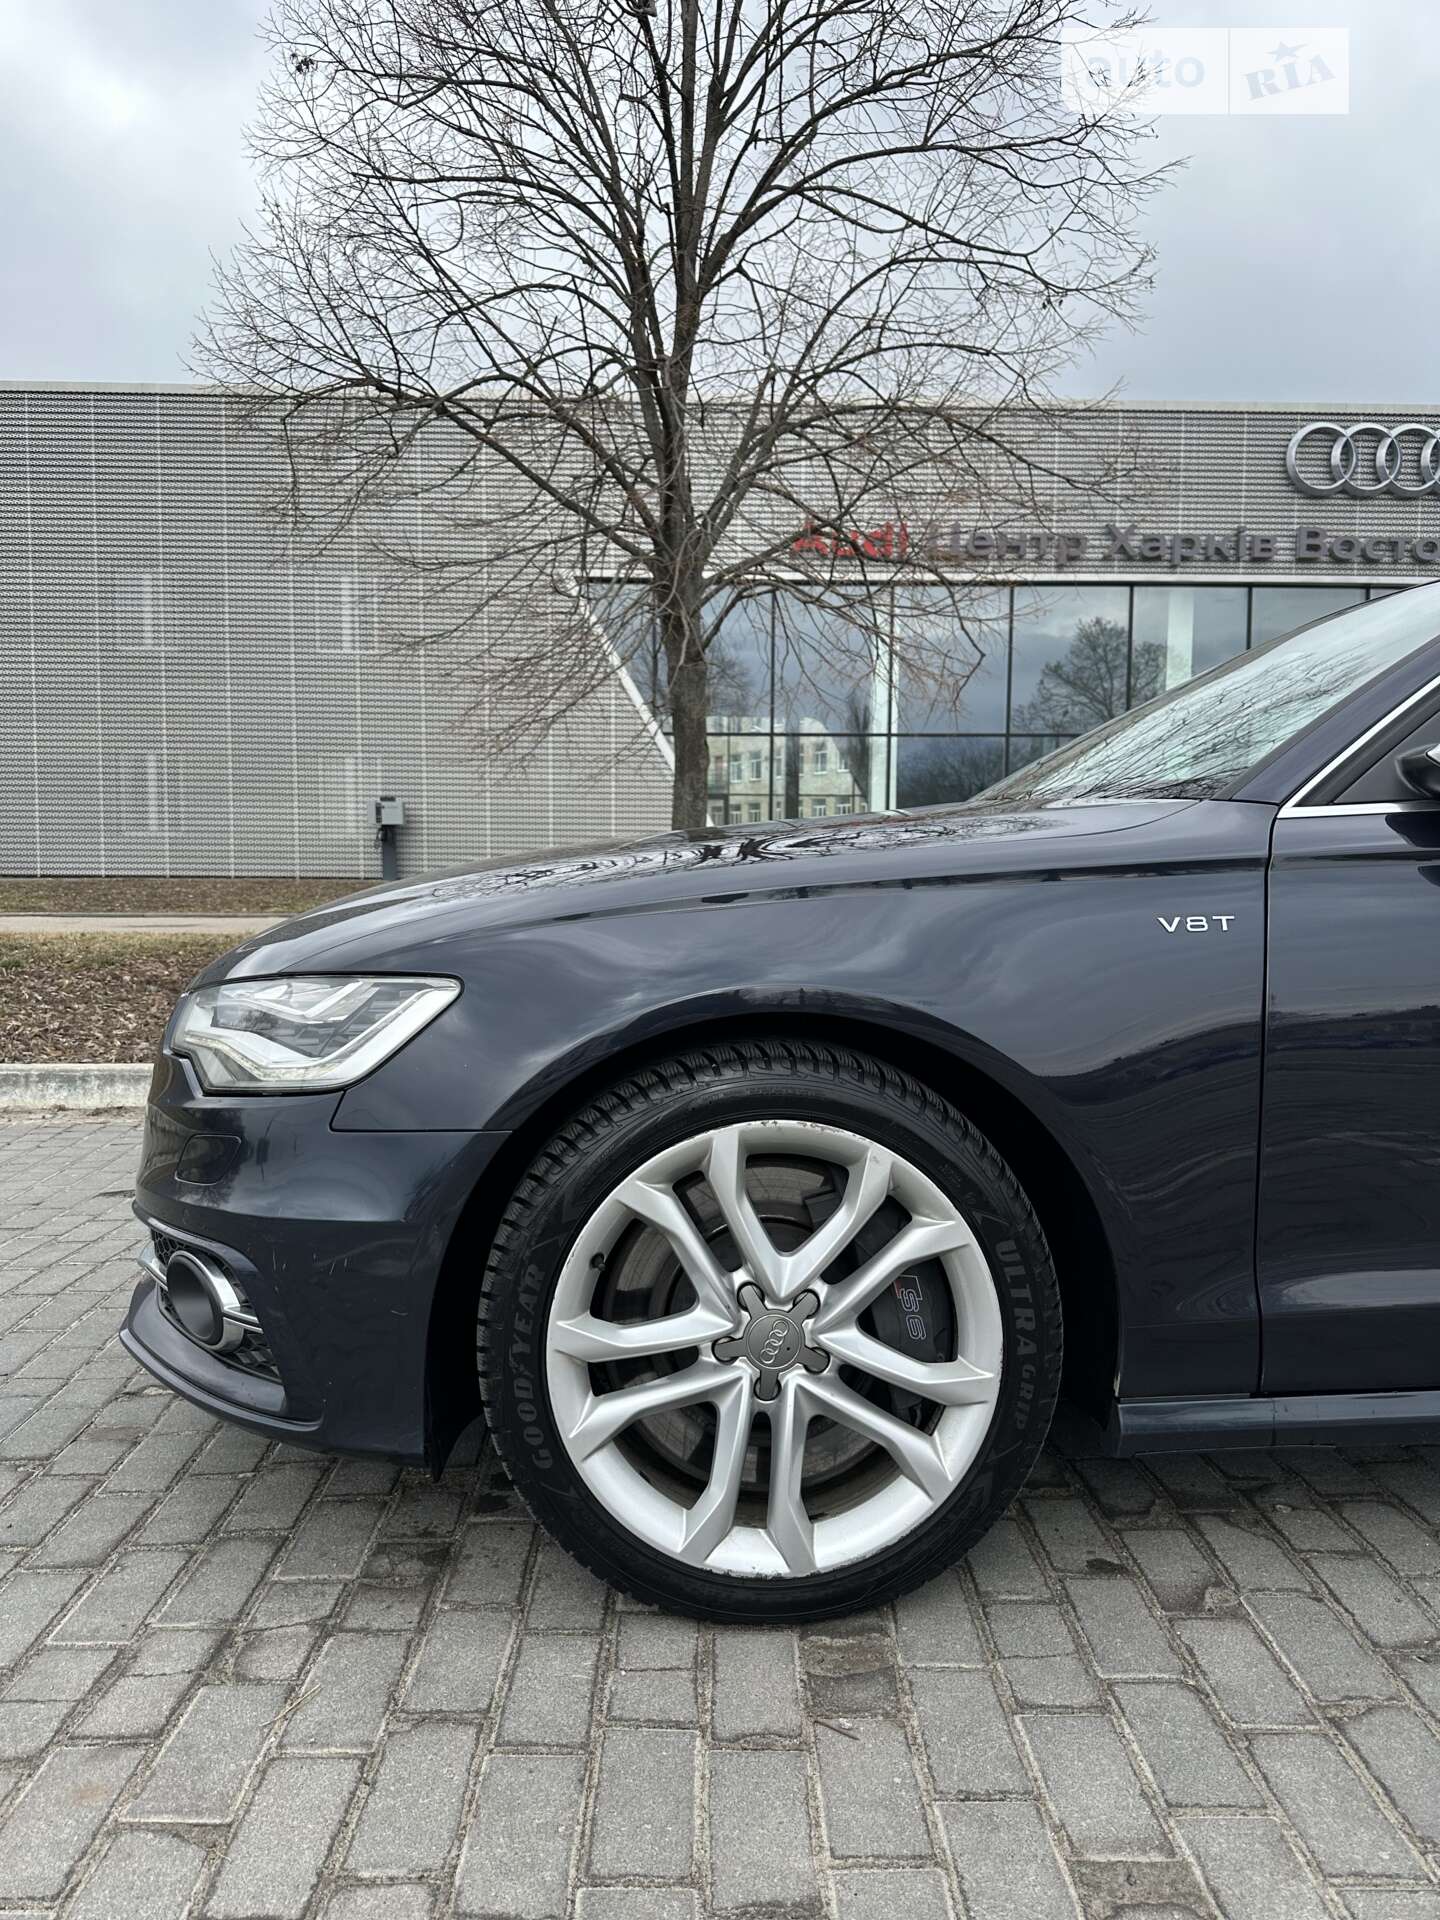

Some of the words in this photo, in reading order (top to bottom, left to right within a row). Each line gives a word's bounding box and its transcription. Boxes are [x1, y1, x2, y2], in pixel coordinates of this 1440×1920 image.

[1157, 915, 1235, 933] V8T
[994, 1238, 1038, 1356] ULTRA
[508, 1263, 554, 1469] GOODYEAR
